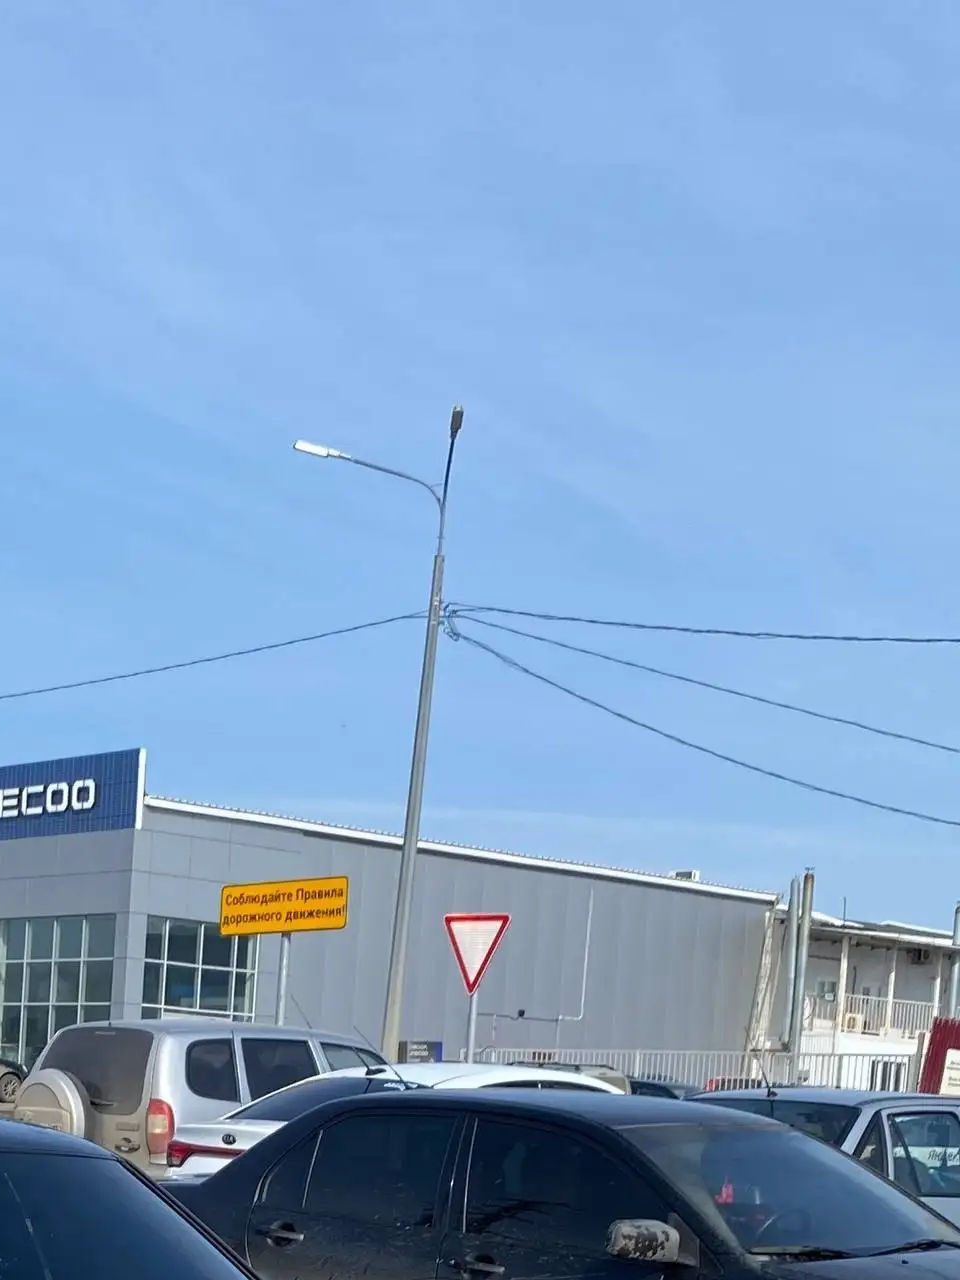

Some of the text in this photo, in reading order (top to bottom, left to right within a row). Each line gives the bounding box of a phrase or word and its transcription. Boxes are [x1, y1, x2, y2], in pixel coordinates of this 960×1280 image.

[225, 887, 344, 906] Соблюдайте Правила
[222, 904, 345, 928] дорожного движения!
